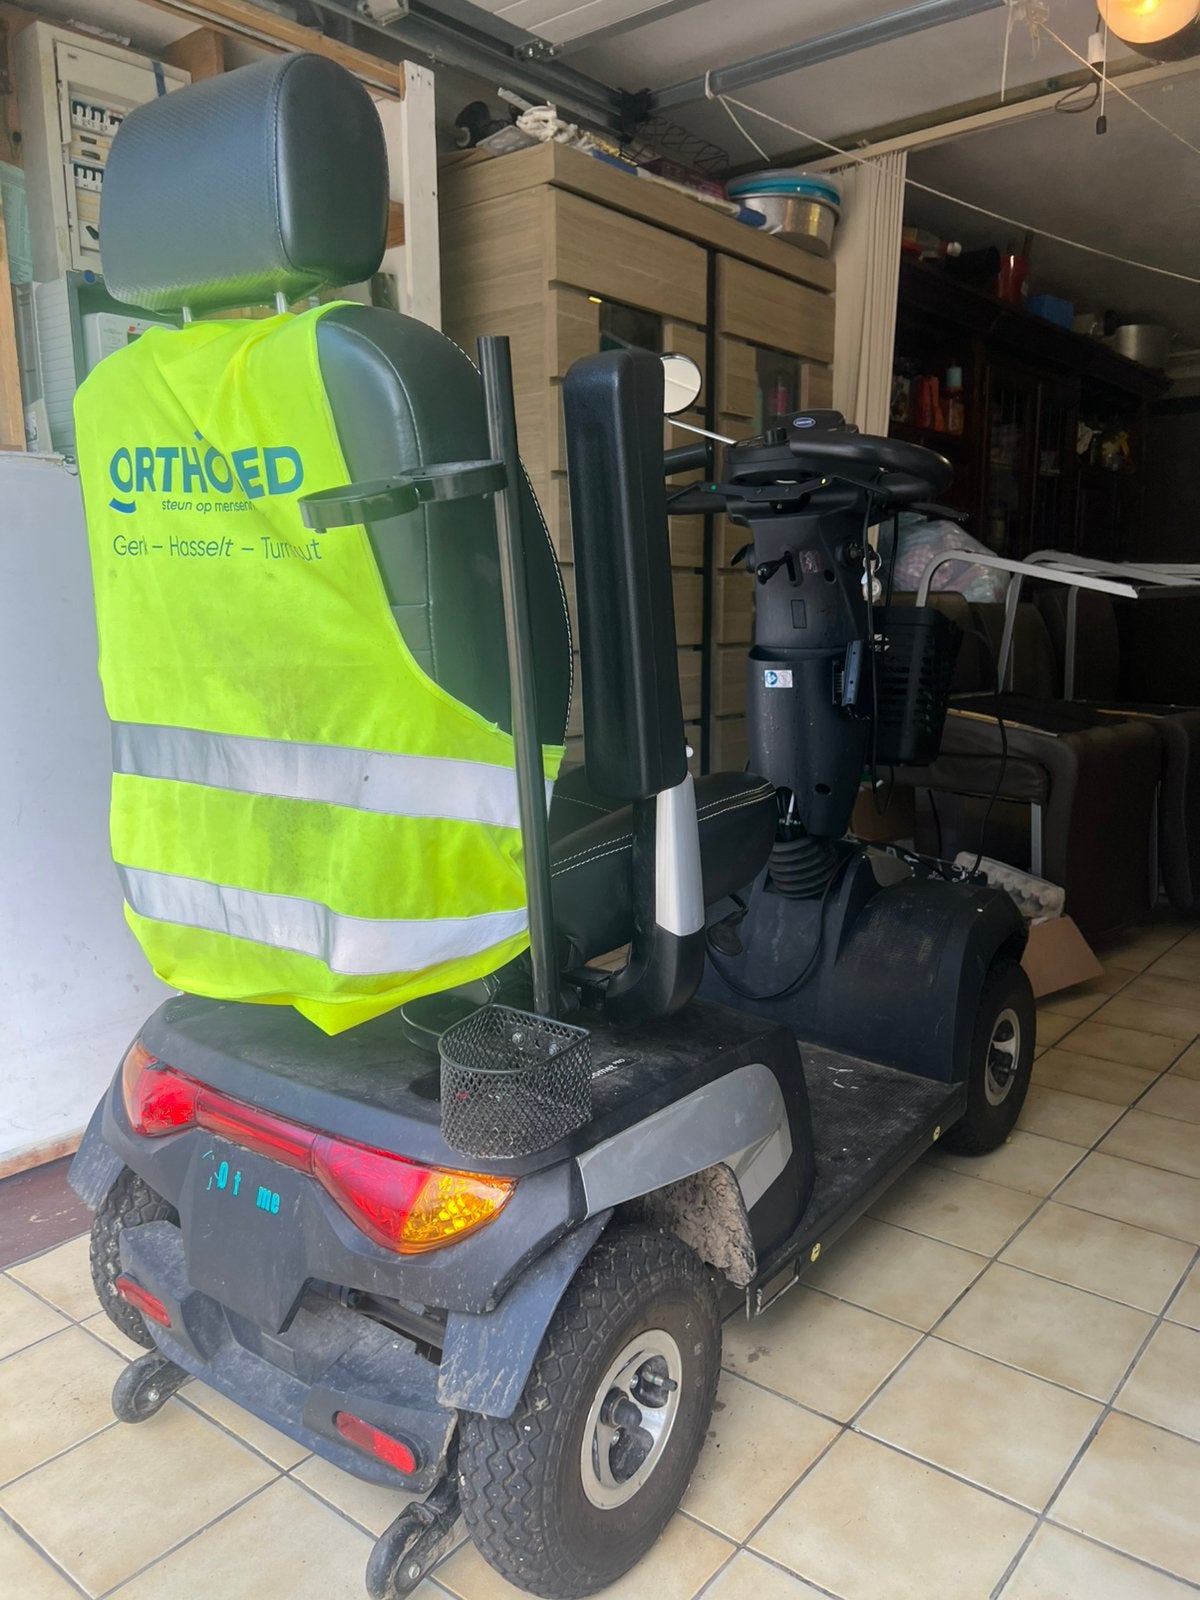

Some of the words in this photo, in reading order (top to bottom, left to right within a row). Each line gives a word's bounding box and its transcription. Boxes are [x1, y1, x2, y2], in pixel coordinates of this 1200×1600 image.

[109, 445, 304, 500] ORTHOED
[162, 499, 192, 511] steun
[196, 502, 212, 515] op
[169, 536, 234, 557] Hasselt
[591, 1065, 618, 1079] omet
